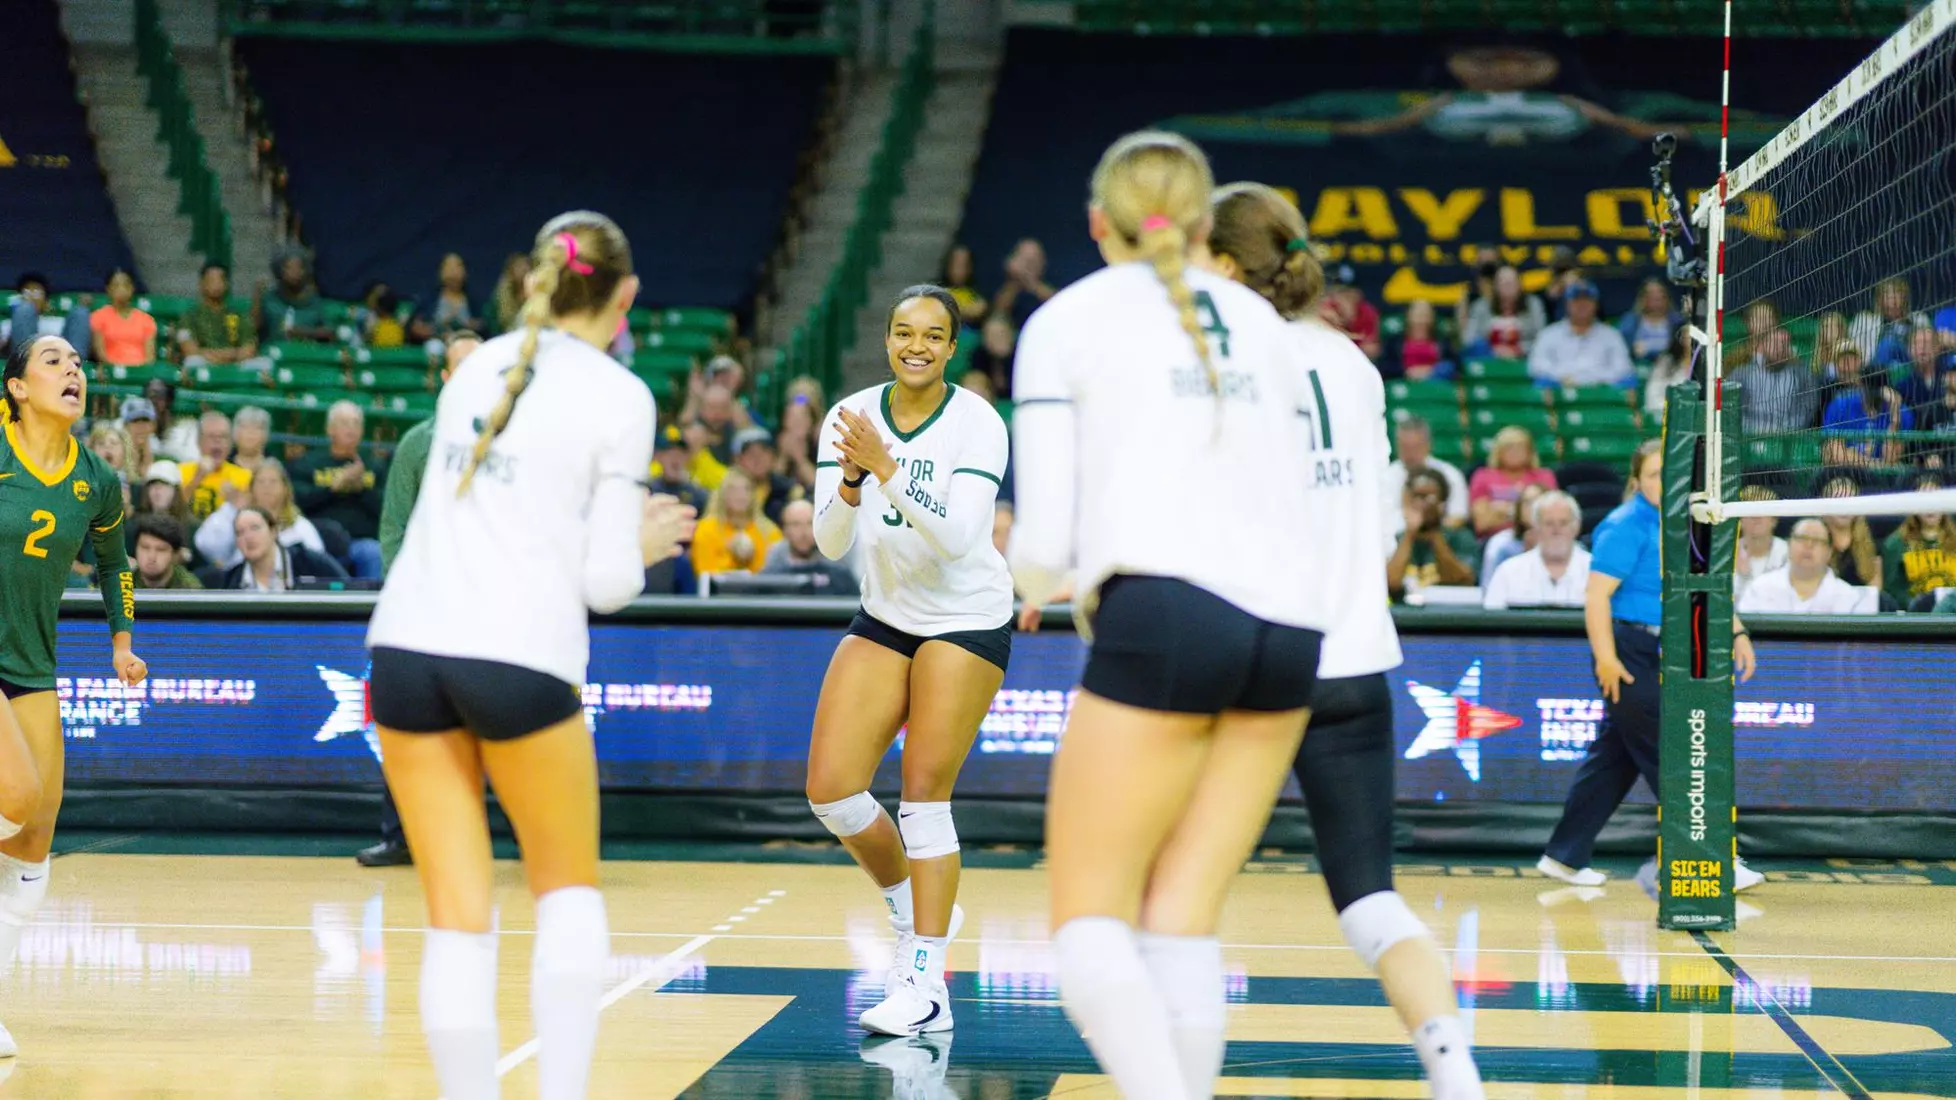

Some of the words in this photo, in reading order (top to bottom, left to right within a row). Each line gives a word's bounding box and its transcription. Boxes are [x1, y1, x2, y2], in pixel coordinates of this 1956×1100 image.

[23, 509, 56, 559] 2
[1688, 709, 1708, 767] sports
[1688, 770, 1708, 841] imports
[1671, 879, 1721, 897] BEARS
